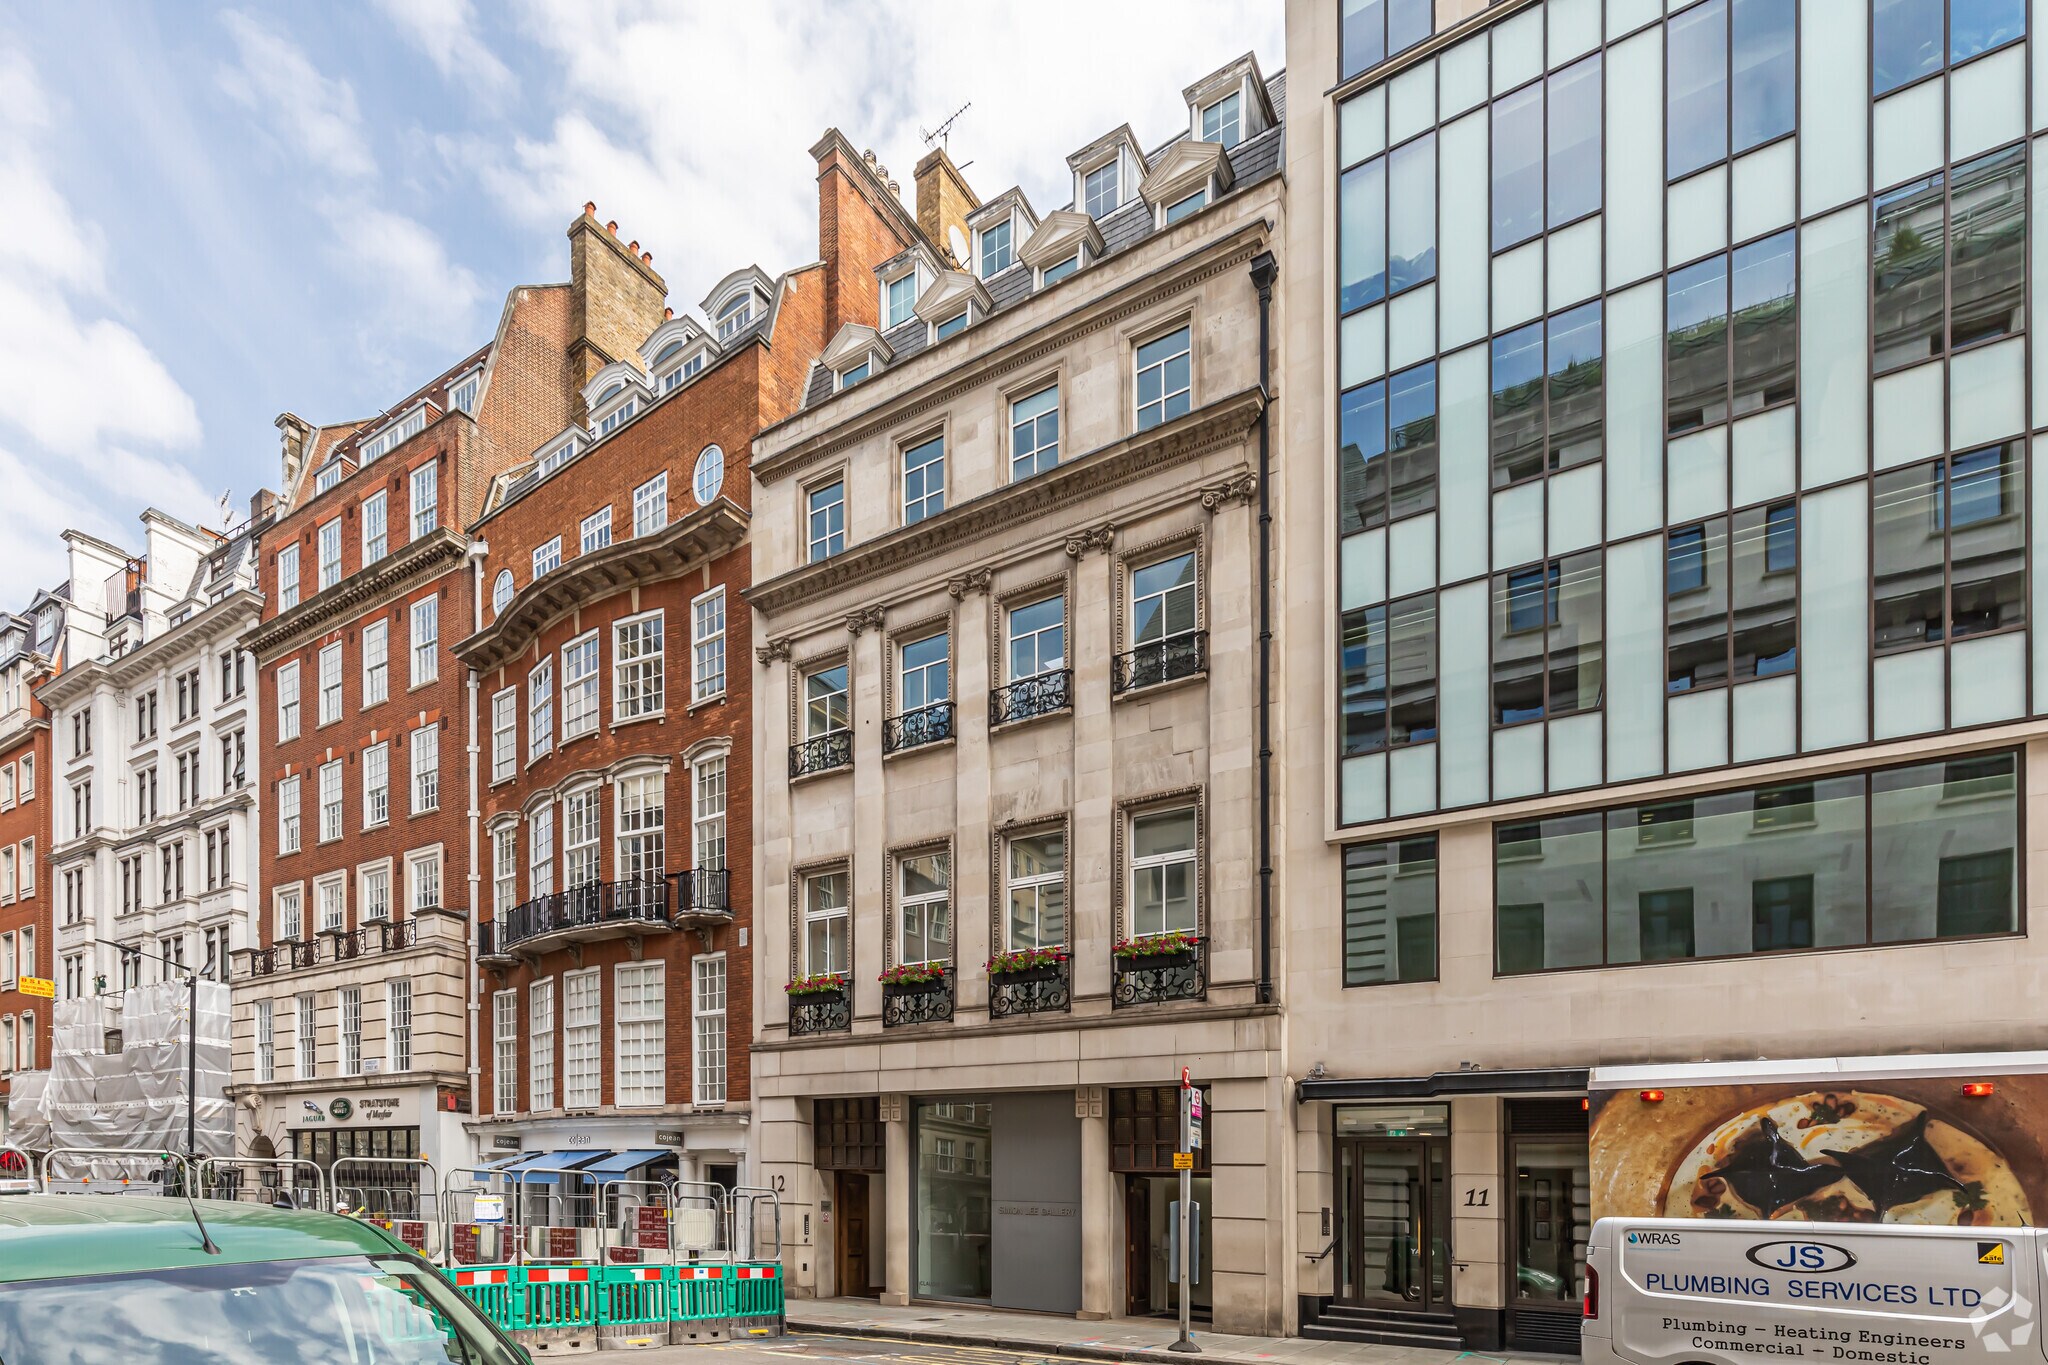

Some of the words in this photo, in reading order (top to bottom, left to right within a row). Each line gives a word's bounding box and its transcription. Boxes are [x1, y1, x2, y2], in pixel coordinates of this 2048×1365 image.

[302, 1115, 326, 1123] JAGUAR
[496, 1138, 518, 1146] cojean
[567, 1133, 591, 1146] cojean
[658, 1133, 681, 1142] cojean
[771, 1174, 785, 1192] 12
[1463, 1188, 1490, 1207] 11
[1041, 1208, 1078, 1218] GALLERY
[1638, 1232, 1680, 1245] WRAS
[1776, 1245, 1825, 1269] JS
[1646, 1273, 1770, 1296] PLUMBING
[1788, 1279, 1918, 1304] SERVICES
[1929, 1286, 1981, 1307] LTD
[1662, 1318, 1747, 1336] Plumbing
[1774, 1325, 1851, 1343] Heating
[1858, 1330, 1966, 1350] Engineers
[1692, 1336, 1804, 1356] Commercial
[1833, 1346, 1930, 1365] Domestic
